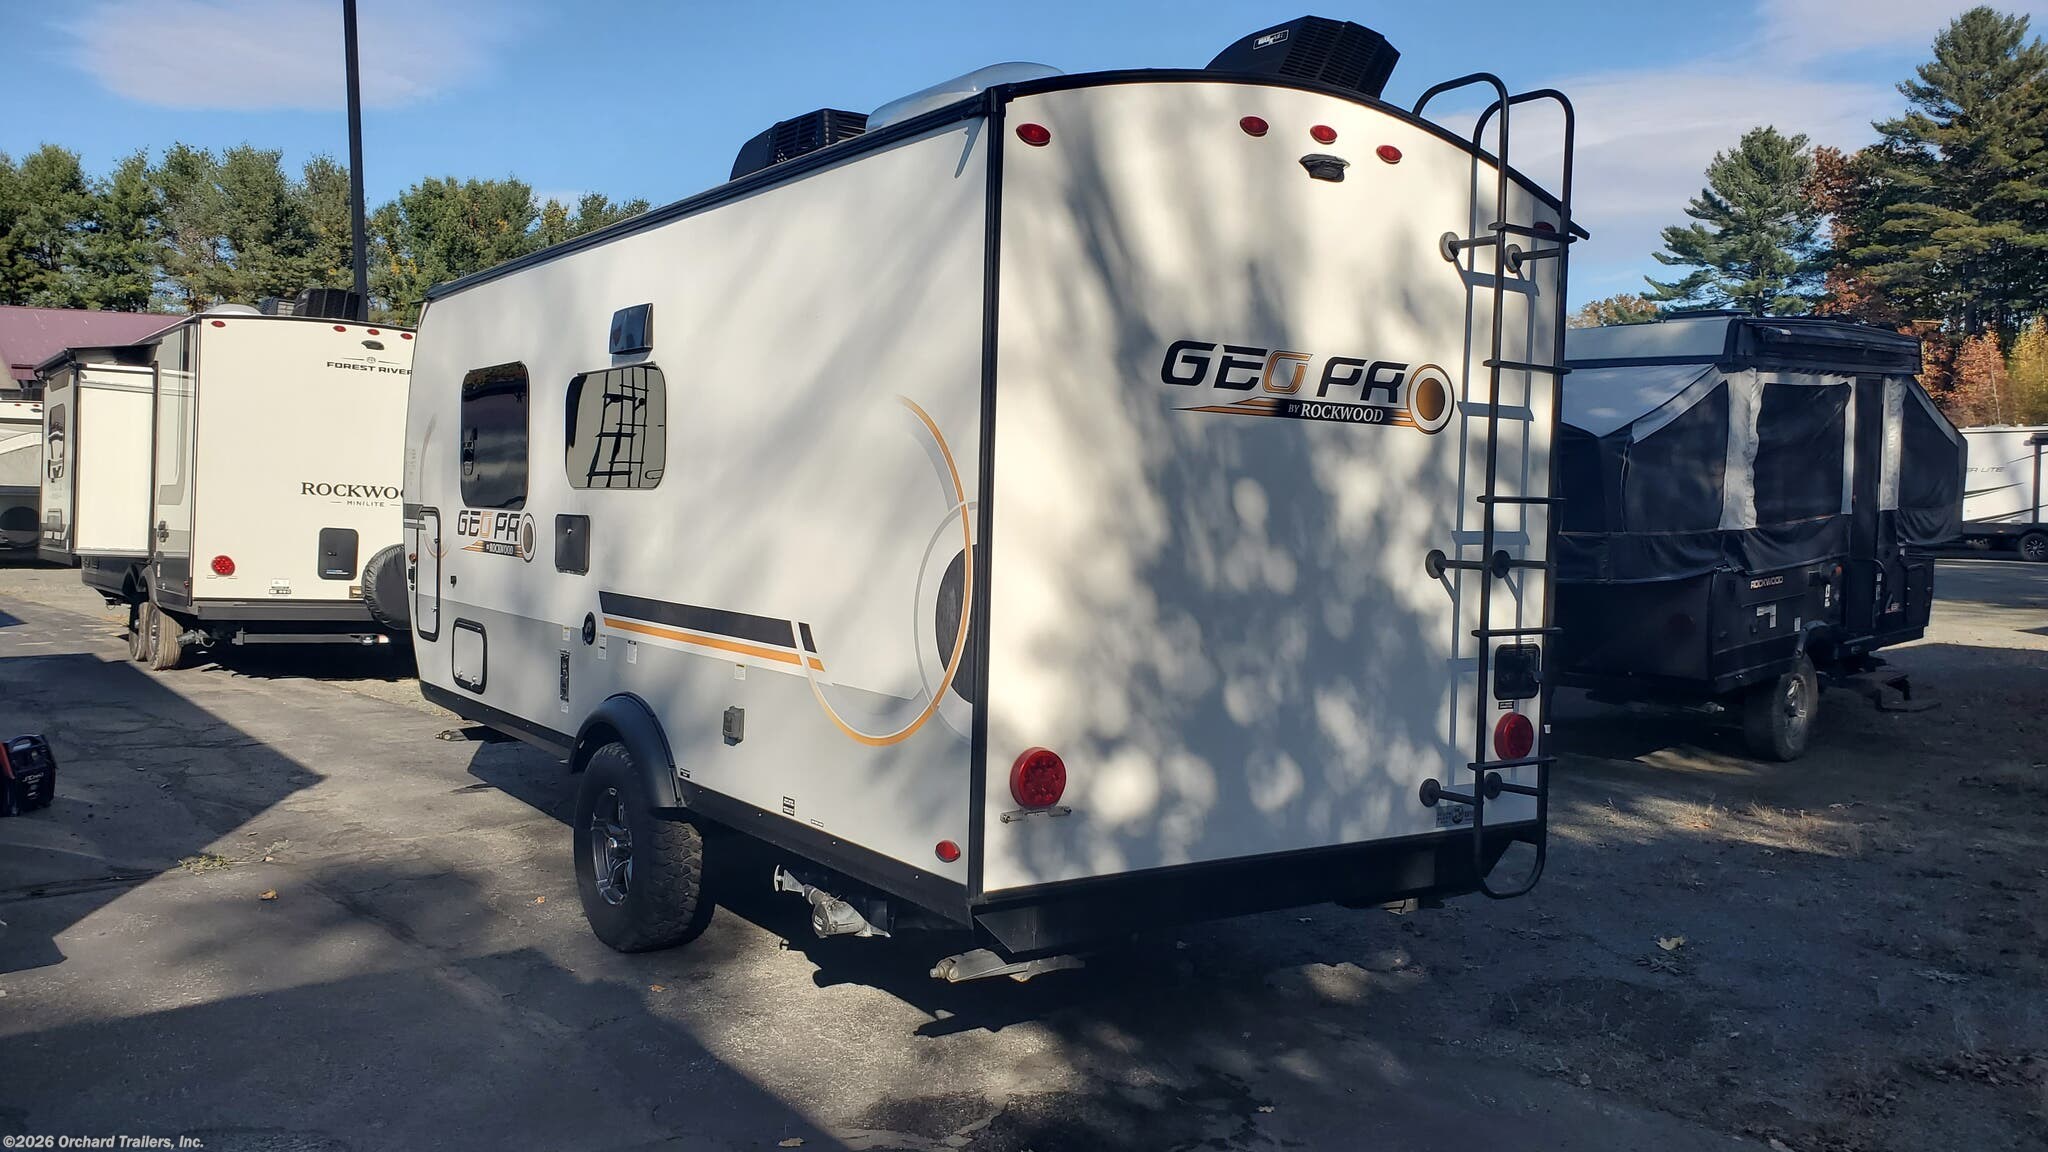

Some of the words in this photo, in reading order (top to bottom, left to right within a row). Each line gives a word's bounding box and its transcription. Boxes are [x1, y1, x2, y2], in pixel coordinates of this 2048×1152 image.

[326, 361, 375, 372] FOREST
[1161, 340, 1313, 395] GEO
[1316, 356, 1455, 435] PRO
[1288, 404, 1300, 413] BY
[1300, 403, 1384, 423] ROCKWOOD
[346, 500, 385, 508] MINILITE
[457, 510, 493, 538] GEO
[494, 512, 537, 563] PRO
[1750, 575, 1784, 589] ROCKWOOD
